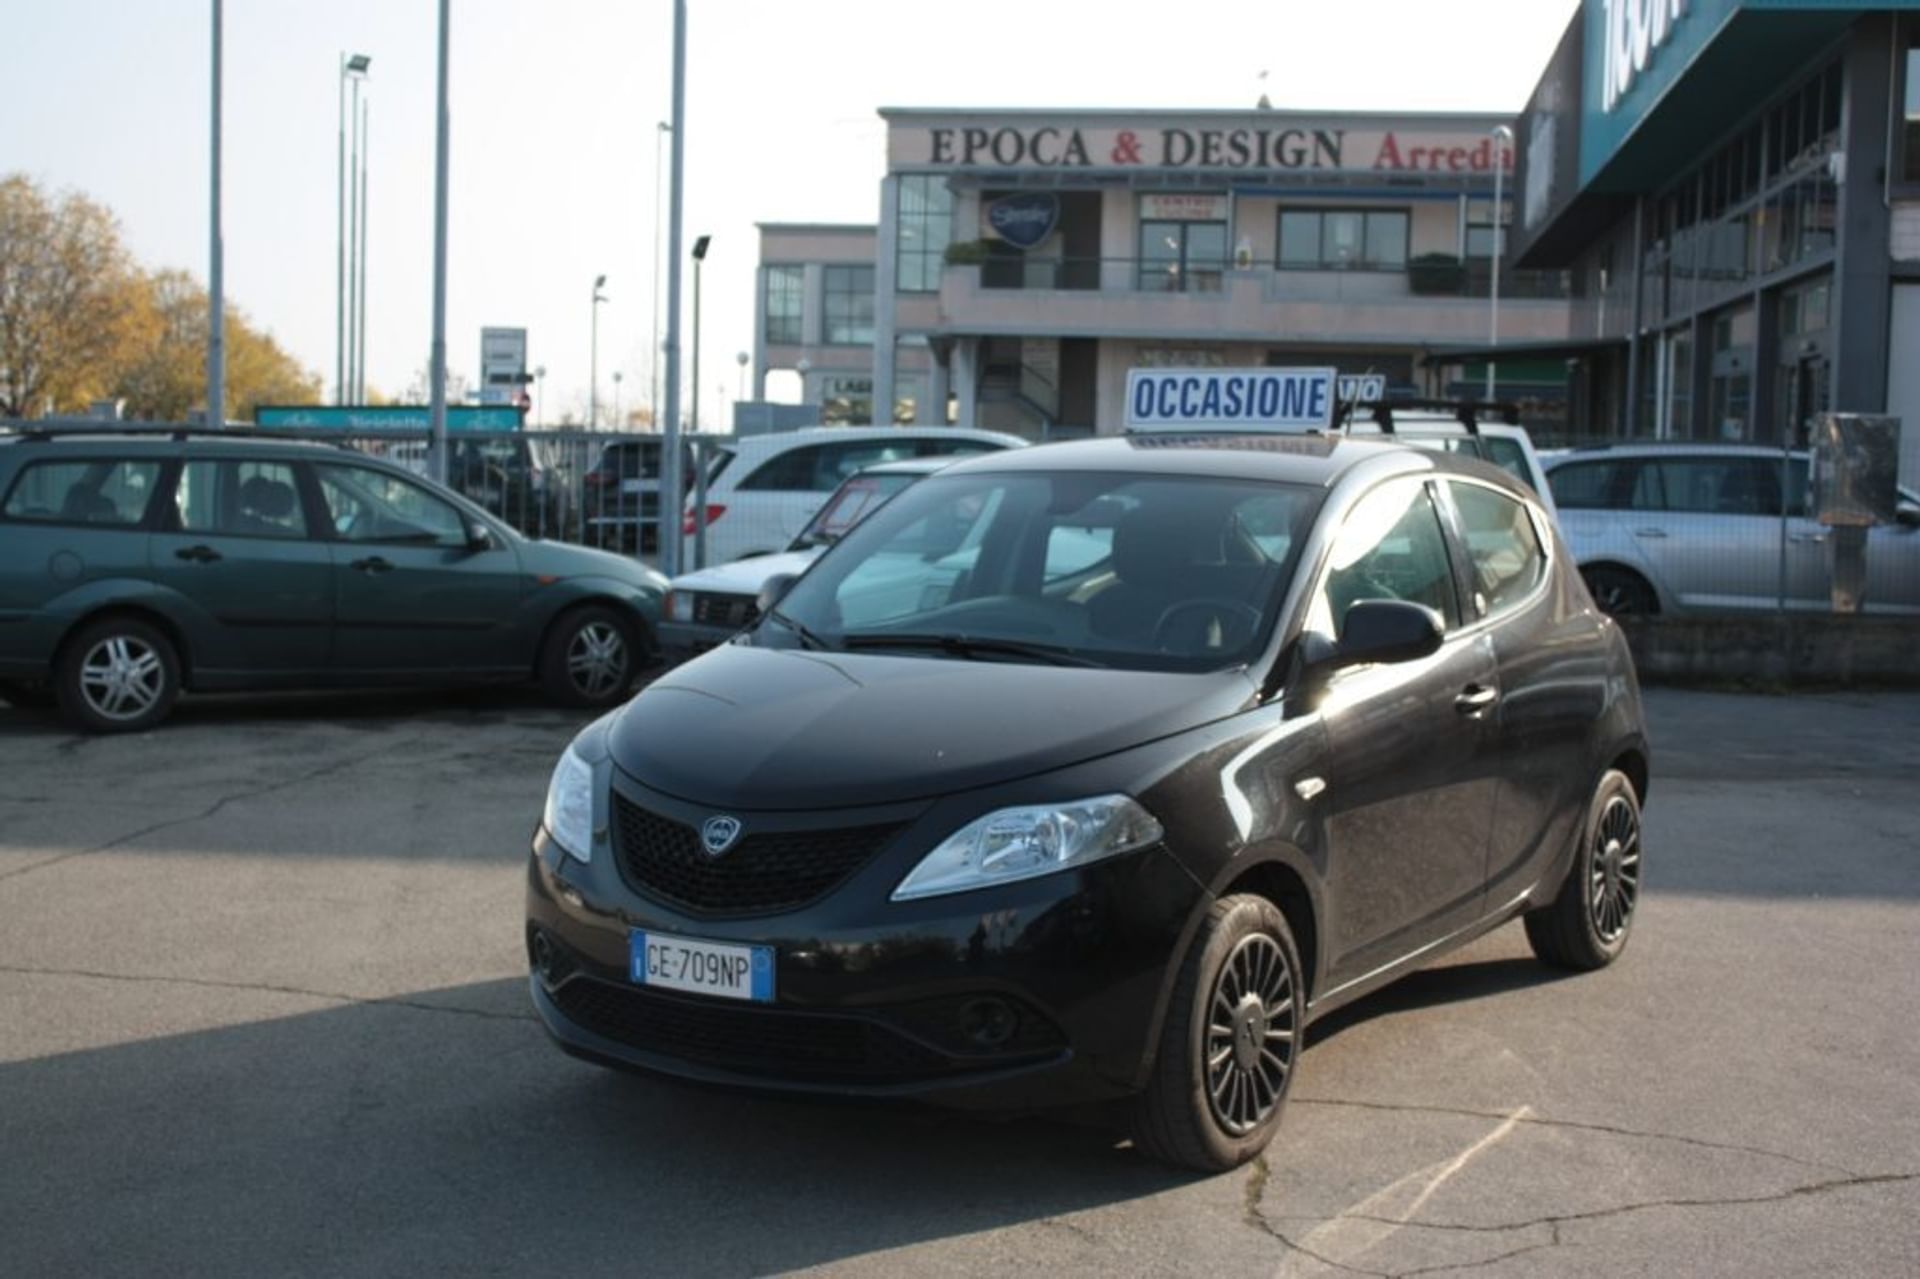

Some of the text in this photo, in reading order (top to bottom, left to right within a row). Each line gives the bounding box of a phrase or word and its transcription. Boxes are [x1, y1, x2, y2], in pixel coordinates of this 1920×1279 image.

[929, 126, 1092, 166] EPOCA
[1111, 130, 1143, 164] &
[1161, 128, 1345, 167] DESIGN
[1134, 377, 1326, 418] OCCASIONE
